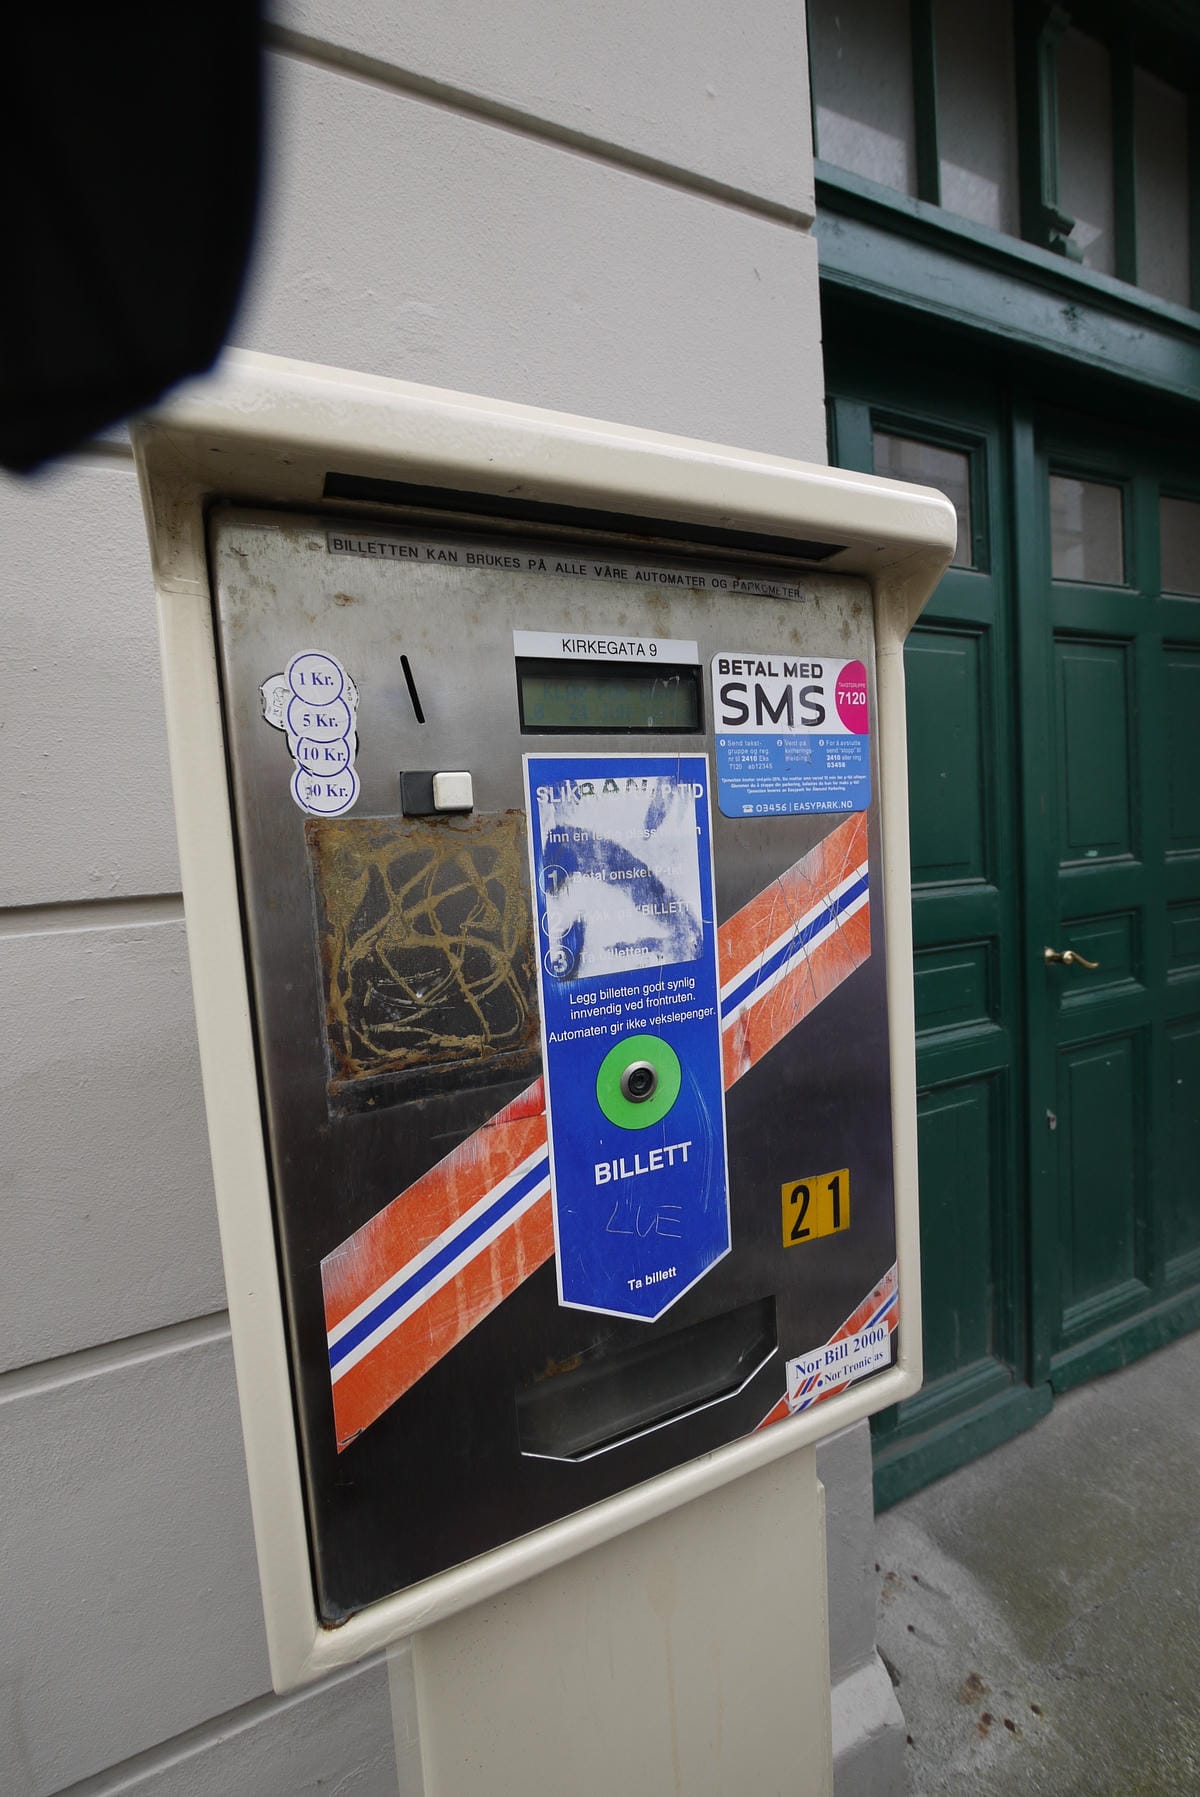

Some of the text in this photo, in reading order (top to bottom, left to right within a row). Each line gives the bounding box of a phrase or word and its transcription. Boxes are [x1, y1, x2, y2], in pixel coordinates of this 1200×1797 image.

[333, 538, 418, 558] BILLETTEN
[426, 548, 458, 562] KAN
[466, 553, 521, 569] BRUKES
[528, 558, 547, 571] PÅ
[555, 562, 587, 576] ALLE
[593, 565, 628, 580] VÅRE
[635, 571, 706, 588] AUTOMATER
[711, 578, 728, 589] OG
[562, 639, 658, 657] KIRKEGATA 9
[298, 672, 334, 686] 1 Kr.
[718, 658, 824, 679] BETAL MED
[720, 682, 826, 728] SMS
[838, 691, 866, 706] 7120
[302, 714, 339, 728] 5 Kr.
[302, 748, 347, 762] 10 Kr.
[325, 784, 349, 798] Kr.
[755, 800, 853, 813] 03456 EASYPARK.NO
[569, 977, 695, 1005] Legg billetten godt synlig
[570, 991, 696, 1020] innvendig ved frontruten.
[548, 1006, 717, 1043] Automaten gir ikke vekslepenger.
[594, 1140, 692, 1186] BILLETT
[627, 1266, 678, 1291] Ta billett
[853, 1327, 884, 1353] 2000
